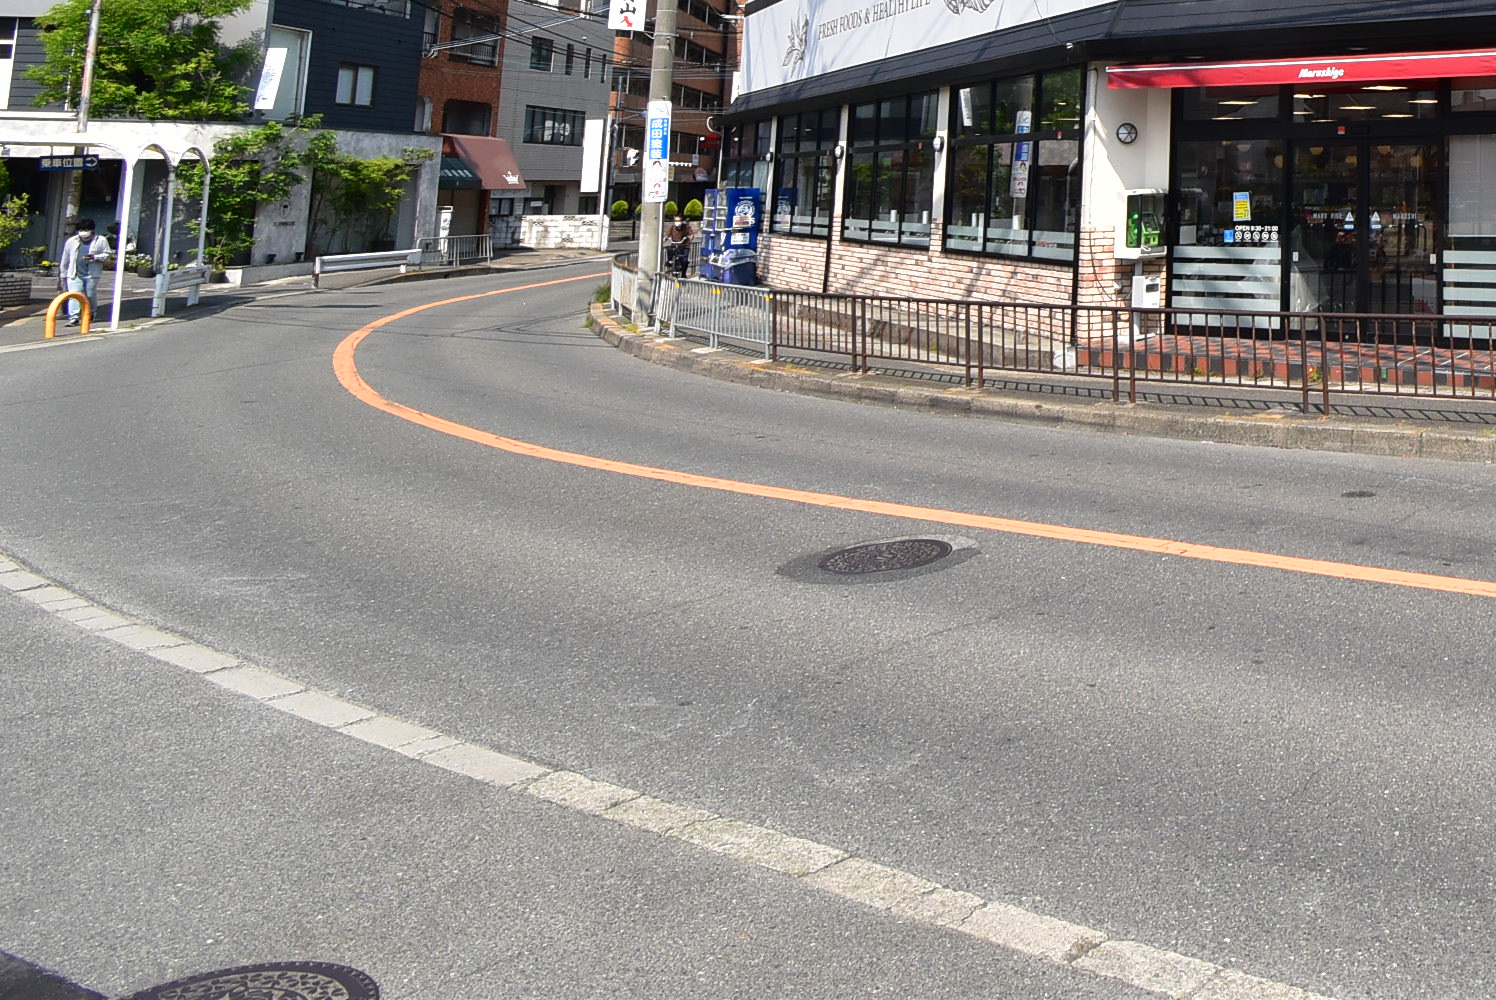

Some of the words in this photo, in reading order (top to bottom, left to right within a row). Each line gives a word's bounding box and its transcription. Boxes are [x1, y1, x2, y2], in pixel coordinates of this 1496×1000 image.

[818, 18, 839, 41] FRESH
[839, 9, 863, 33] FOODS
[864, 7, 871, 25] &
[1298, 66, 1345, 80] Marushige
